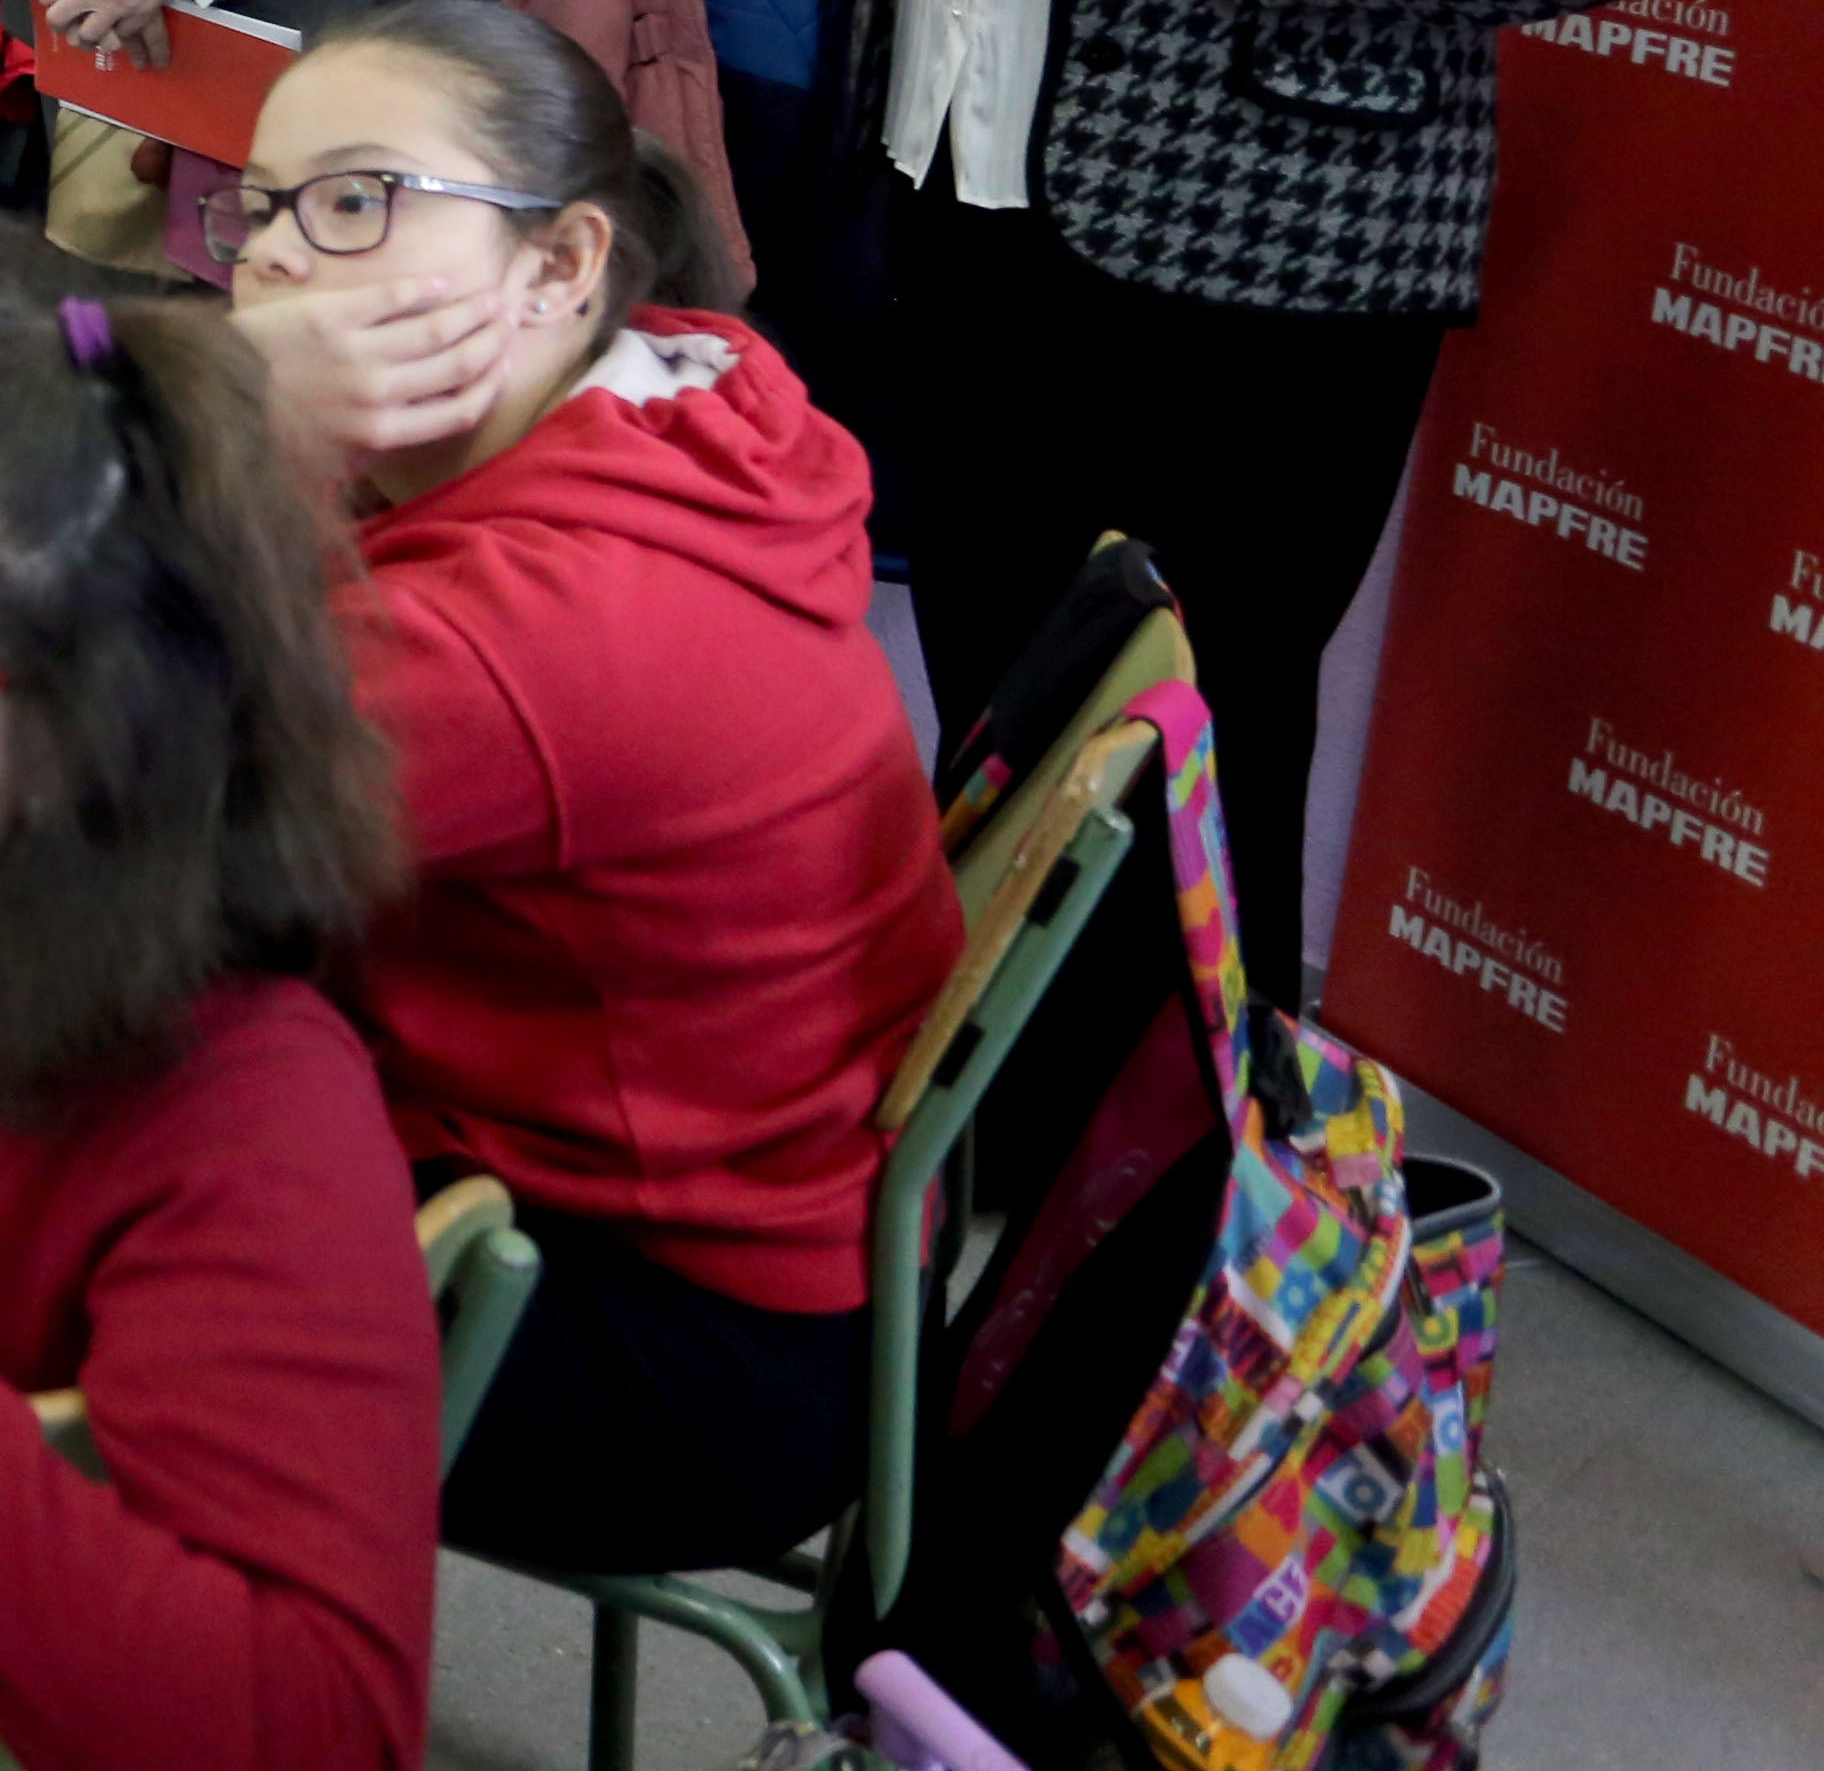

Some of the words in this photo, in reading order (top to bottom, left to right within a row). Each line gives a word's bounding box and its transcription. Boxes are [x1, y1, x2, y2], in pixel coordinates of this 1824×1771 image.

[1653, 286, 1824, 385] MAPFR
[1453, 463, 1650, 572] MAPFRE
[1469, 421, 1645, 522] Fundación
[1567, 757, 1771, 888] MAPFRE
[1586, 716, 1766, 837] Fundación
[1388, 904, 1569, 1034] MAPFRE
[1405, 865, 1565, 984] Fundación
